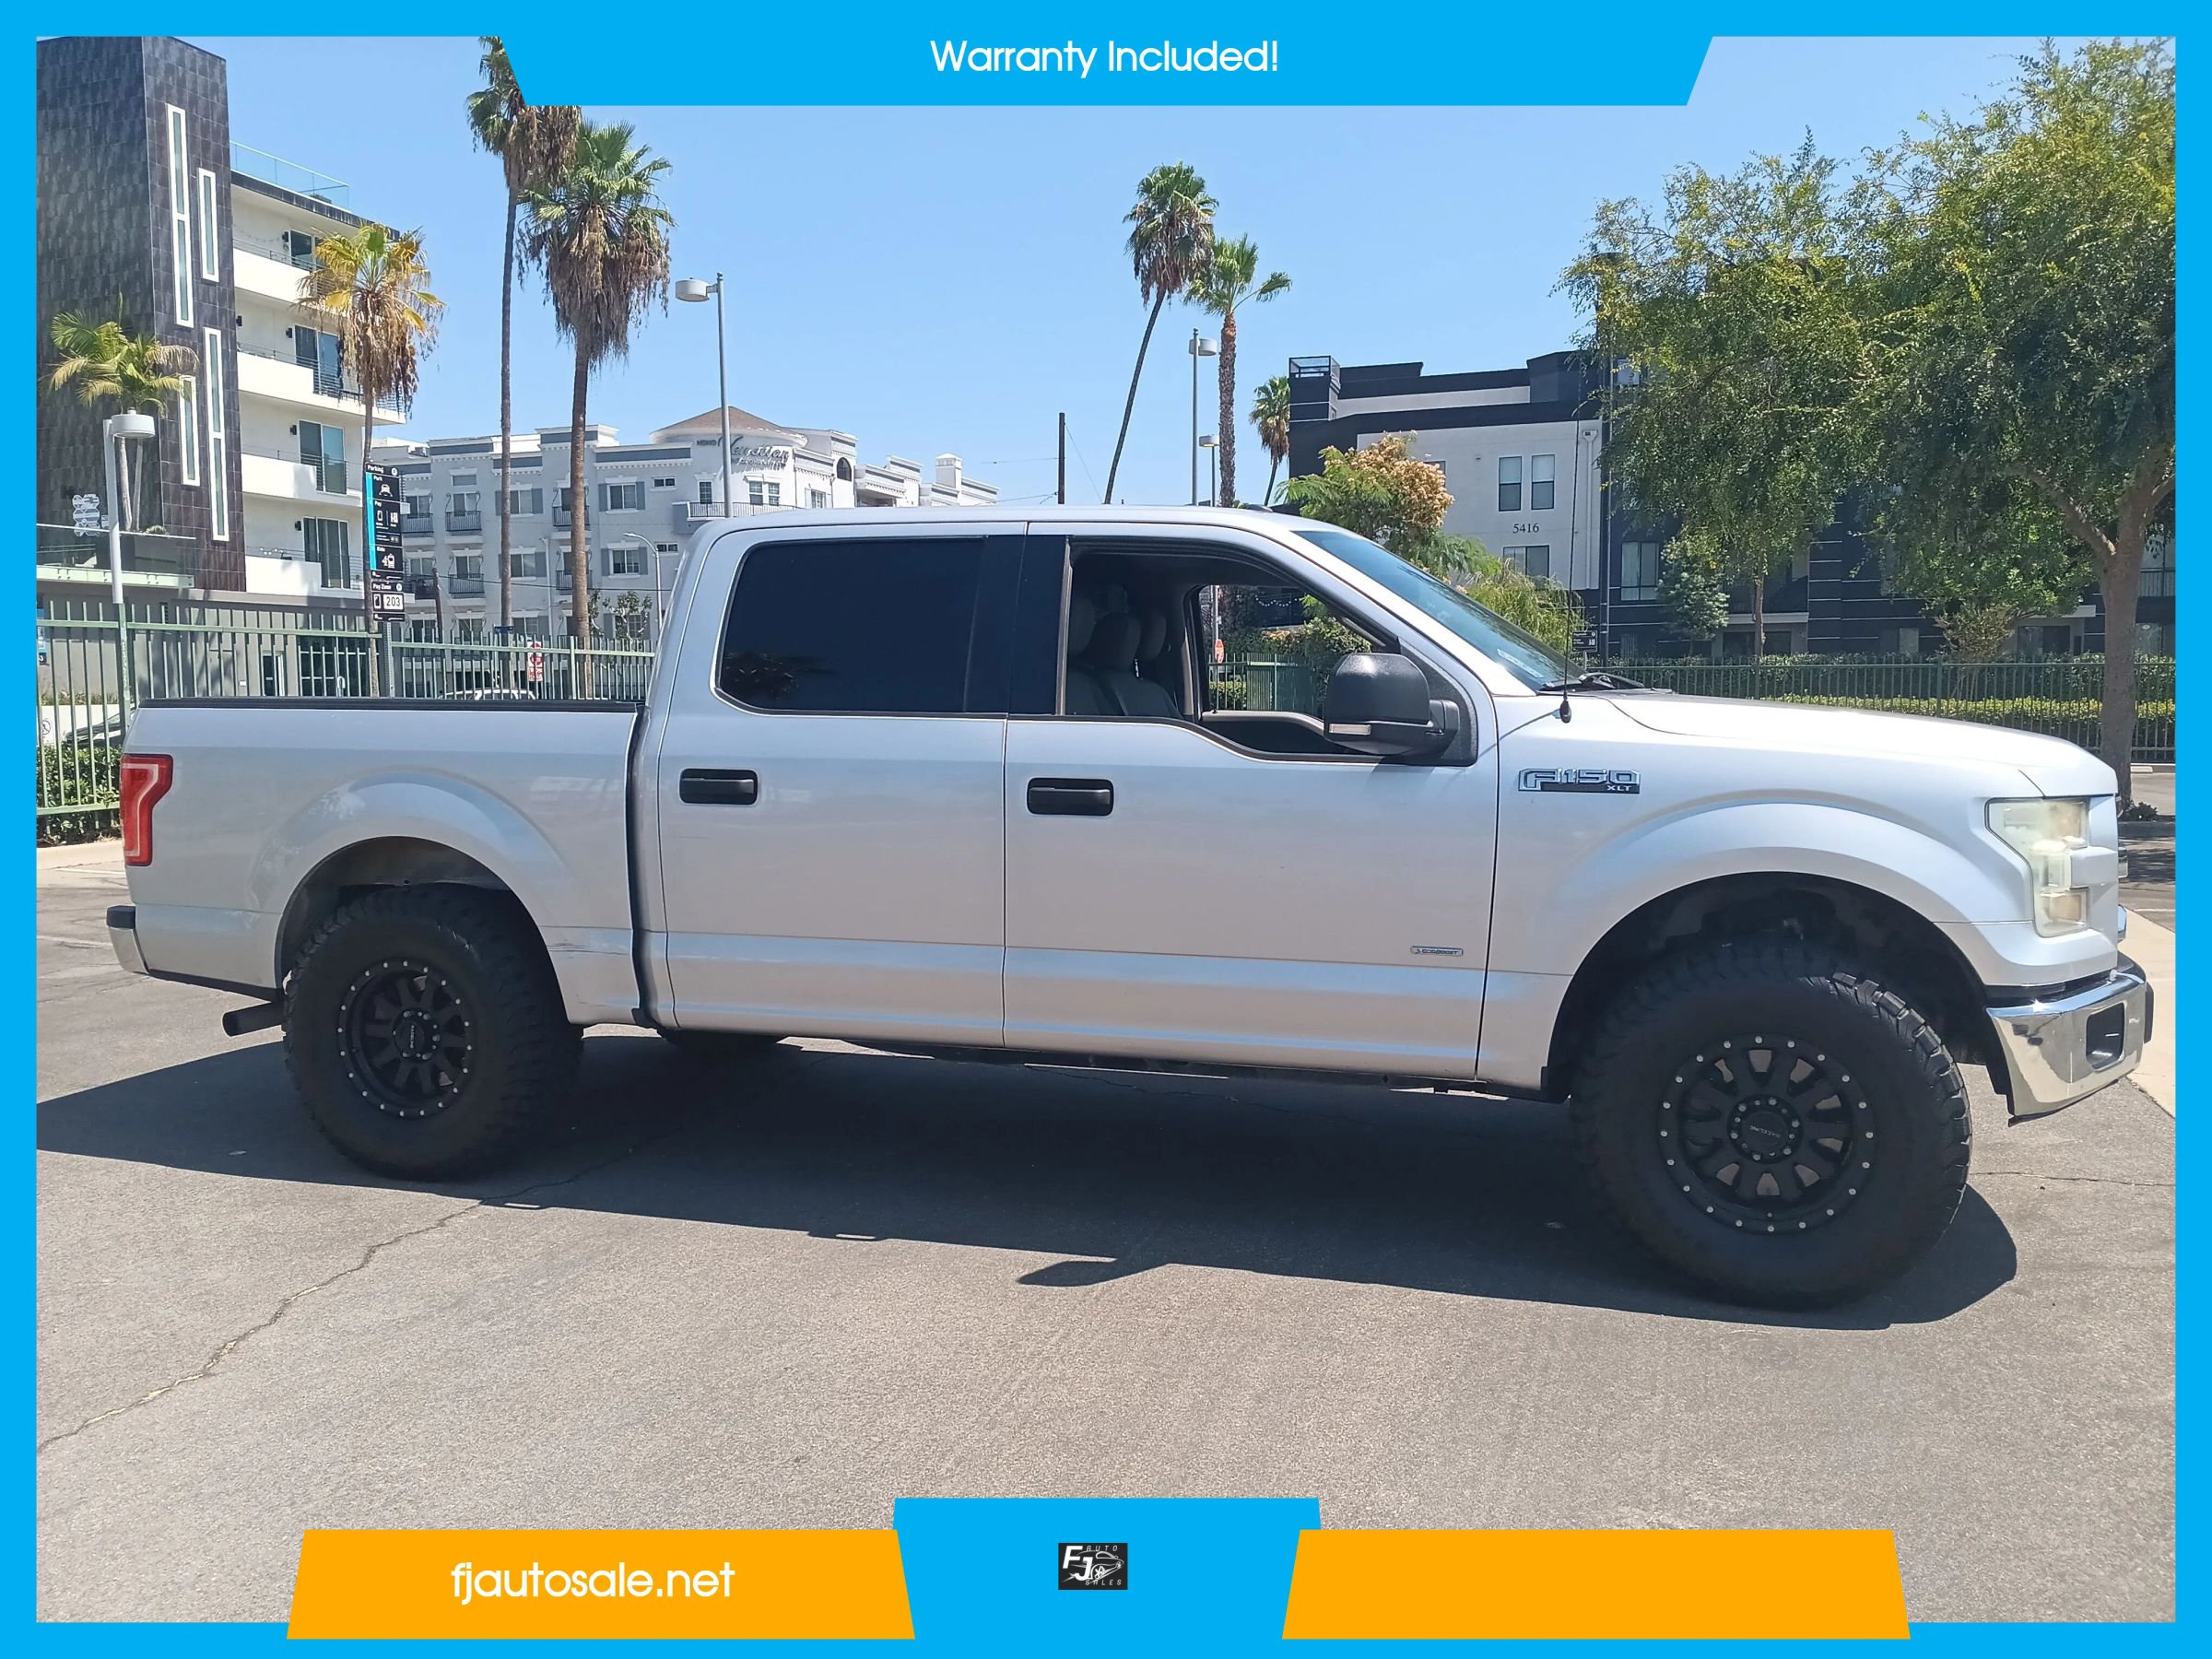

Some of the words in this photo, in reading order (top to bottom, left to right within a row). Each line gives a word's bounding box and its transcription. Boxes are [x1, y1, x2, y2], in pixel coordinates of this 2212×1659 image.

[367, 465, 384, 474] Parking
[1512, 522, 1539, 534] 5416
[386, 596, 401, 606] 203
